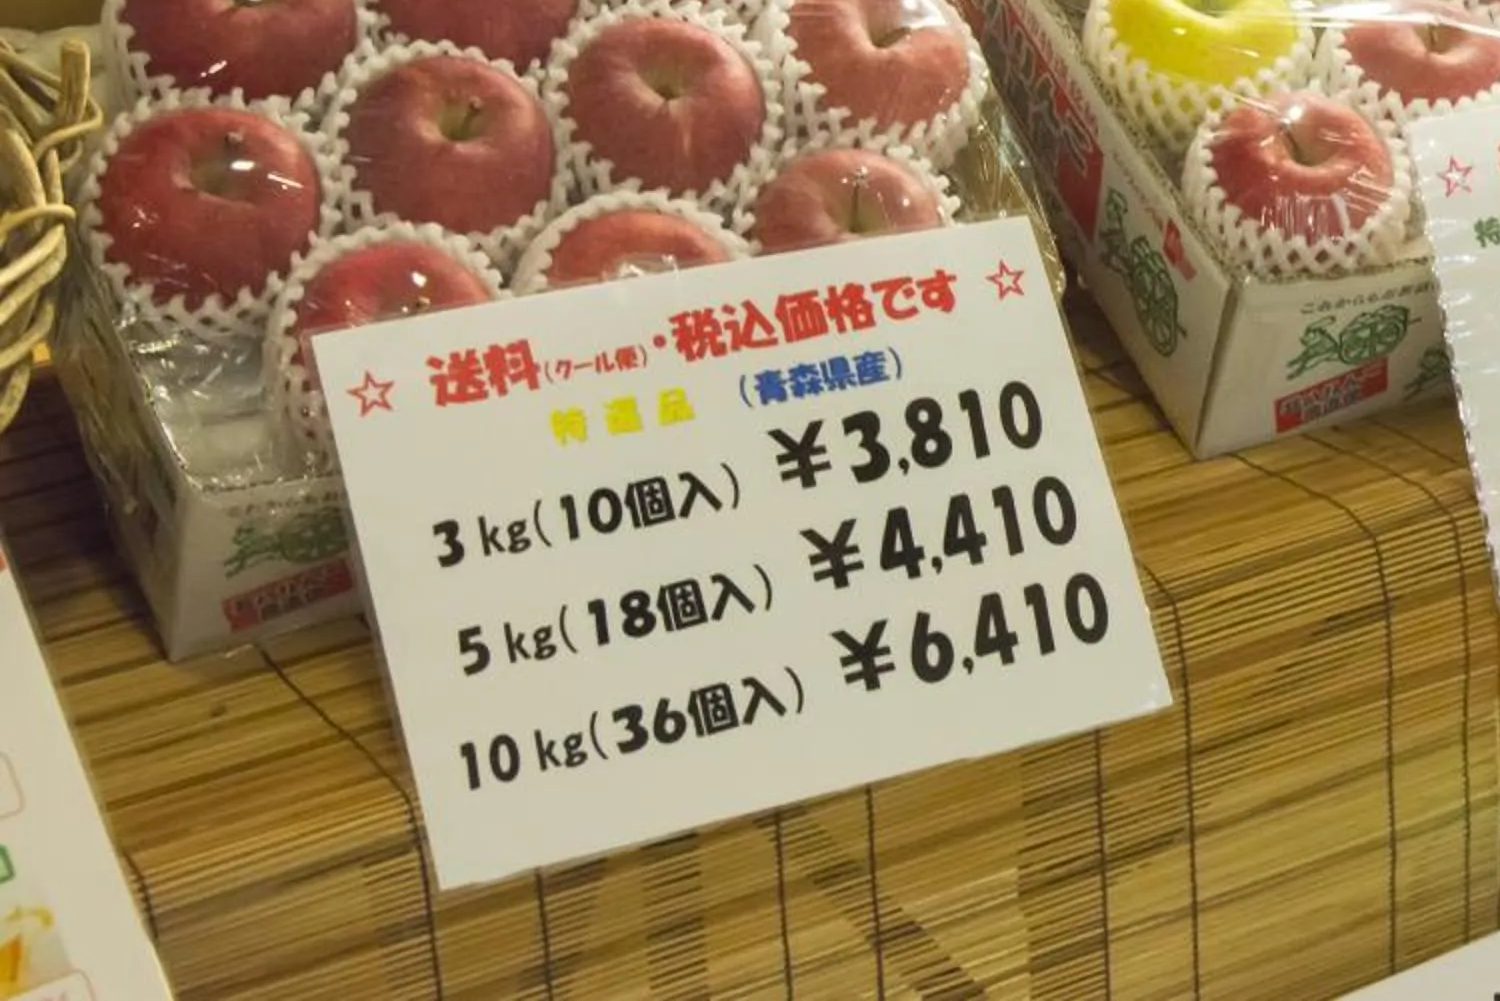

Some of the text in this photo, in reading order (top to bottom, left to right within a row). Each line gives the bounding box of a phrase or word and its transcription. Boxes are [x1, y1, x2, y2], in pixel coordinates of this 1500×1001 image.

[737, 347, 905, 409] （青森県産）
[768, 380, 1043, 489] ¥3,810
[801, 475, 1078, 590] ¥4,410
[830, 572, 1110, 693] ¥6,410
